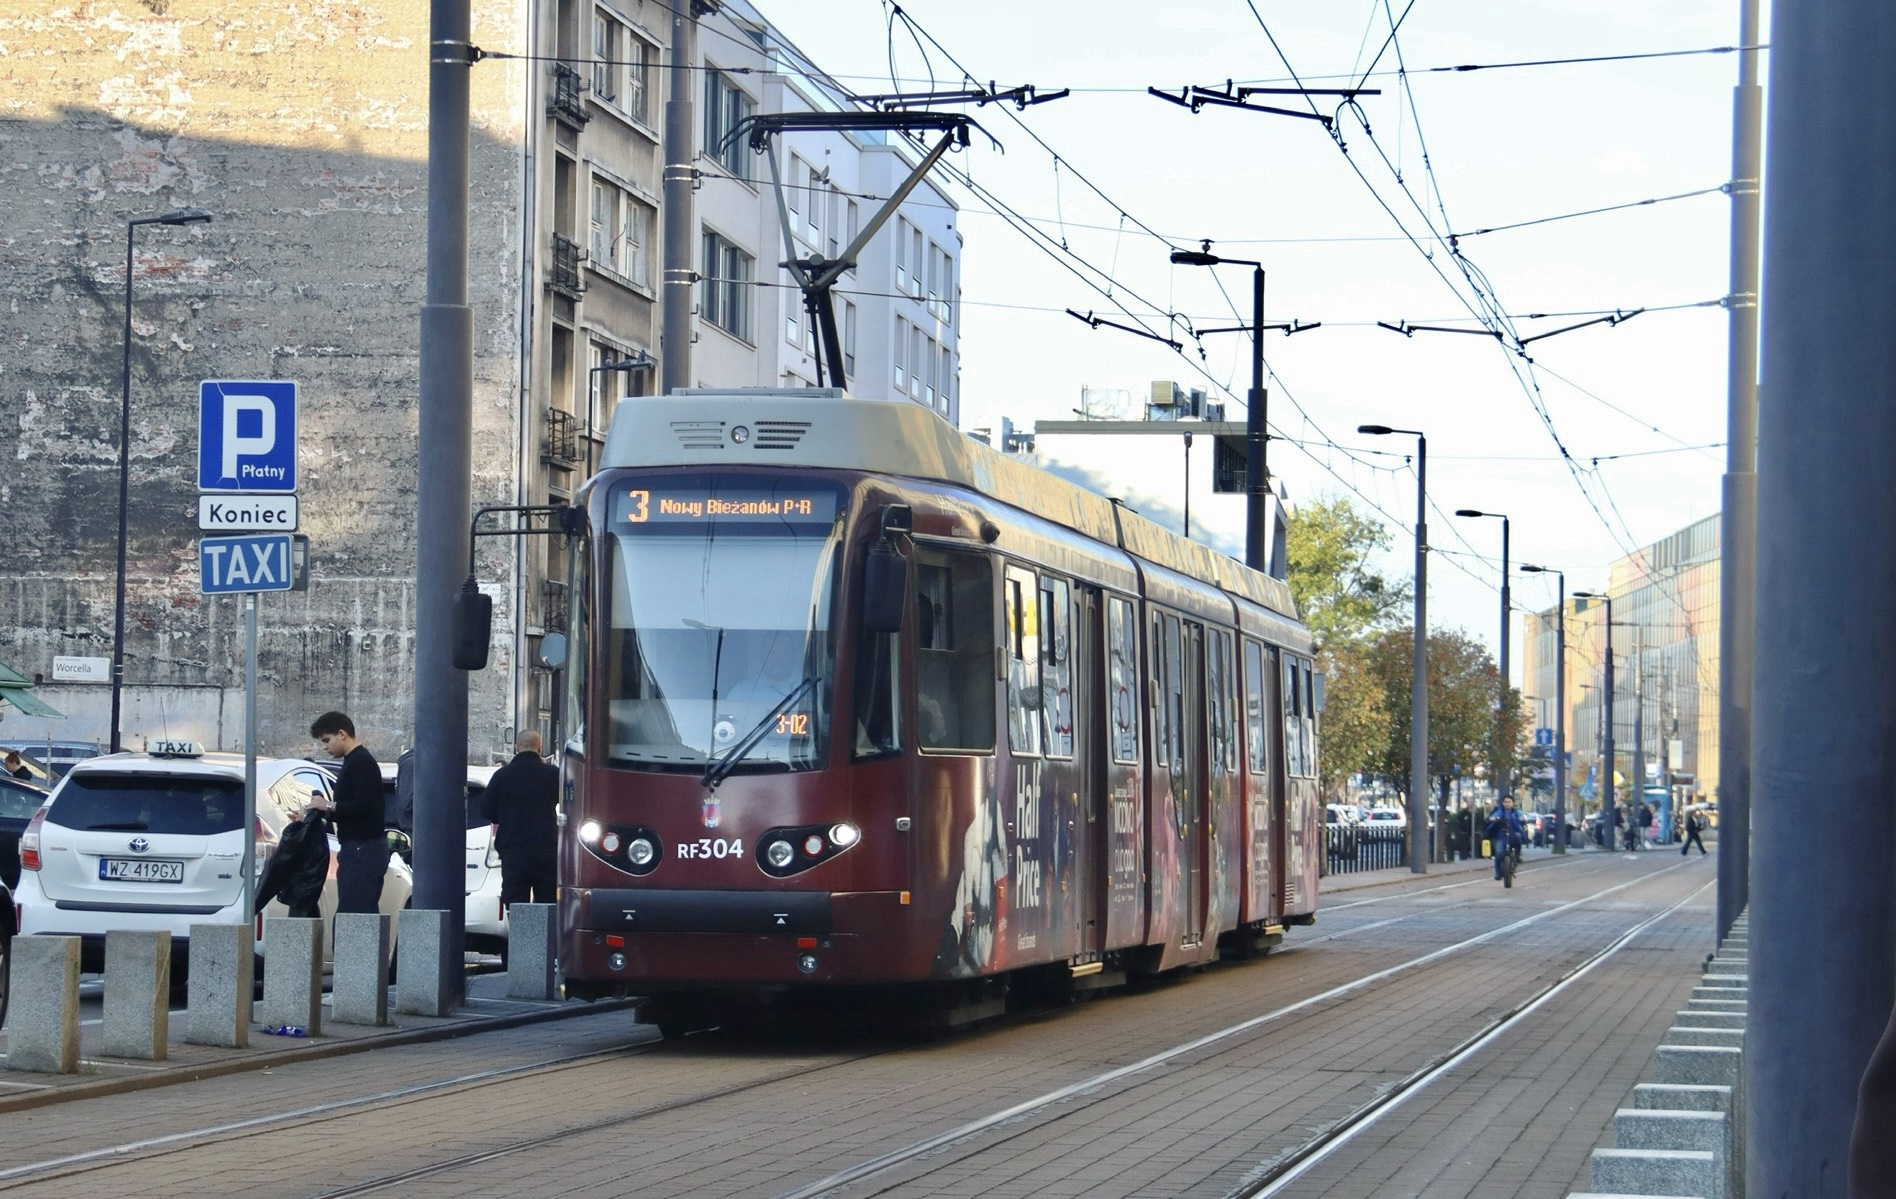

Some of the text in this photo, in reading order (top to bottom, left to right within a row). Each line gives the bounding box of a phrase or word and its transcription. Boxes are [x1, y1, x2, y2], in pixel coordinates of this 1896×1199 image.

[222, 395, 276, 479] P
[242, 464, 285, 480] Płatny
[210, 504, 287, 524] Koniec
[628, 490, 811, 522] 3 Nowy Bieżanów P+R
[204, 542, 287, 586] TAXI
[56, 663, 92, 673] Worcella
[776, 714, 808, 735] 3-02
[156, 742, 192, 753] TAXI
[1016, 761, 1041, 840] Half
[678, 838, 744, 859] RF304
[110, 862, 178, 879] WZ 419GX
[1016, 844, 1040, 909] Price
